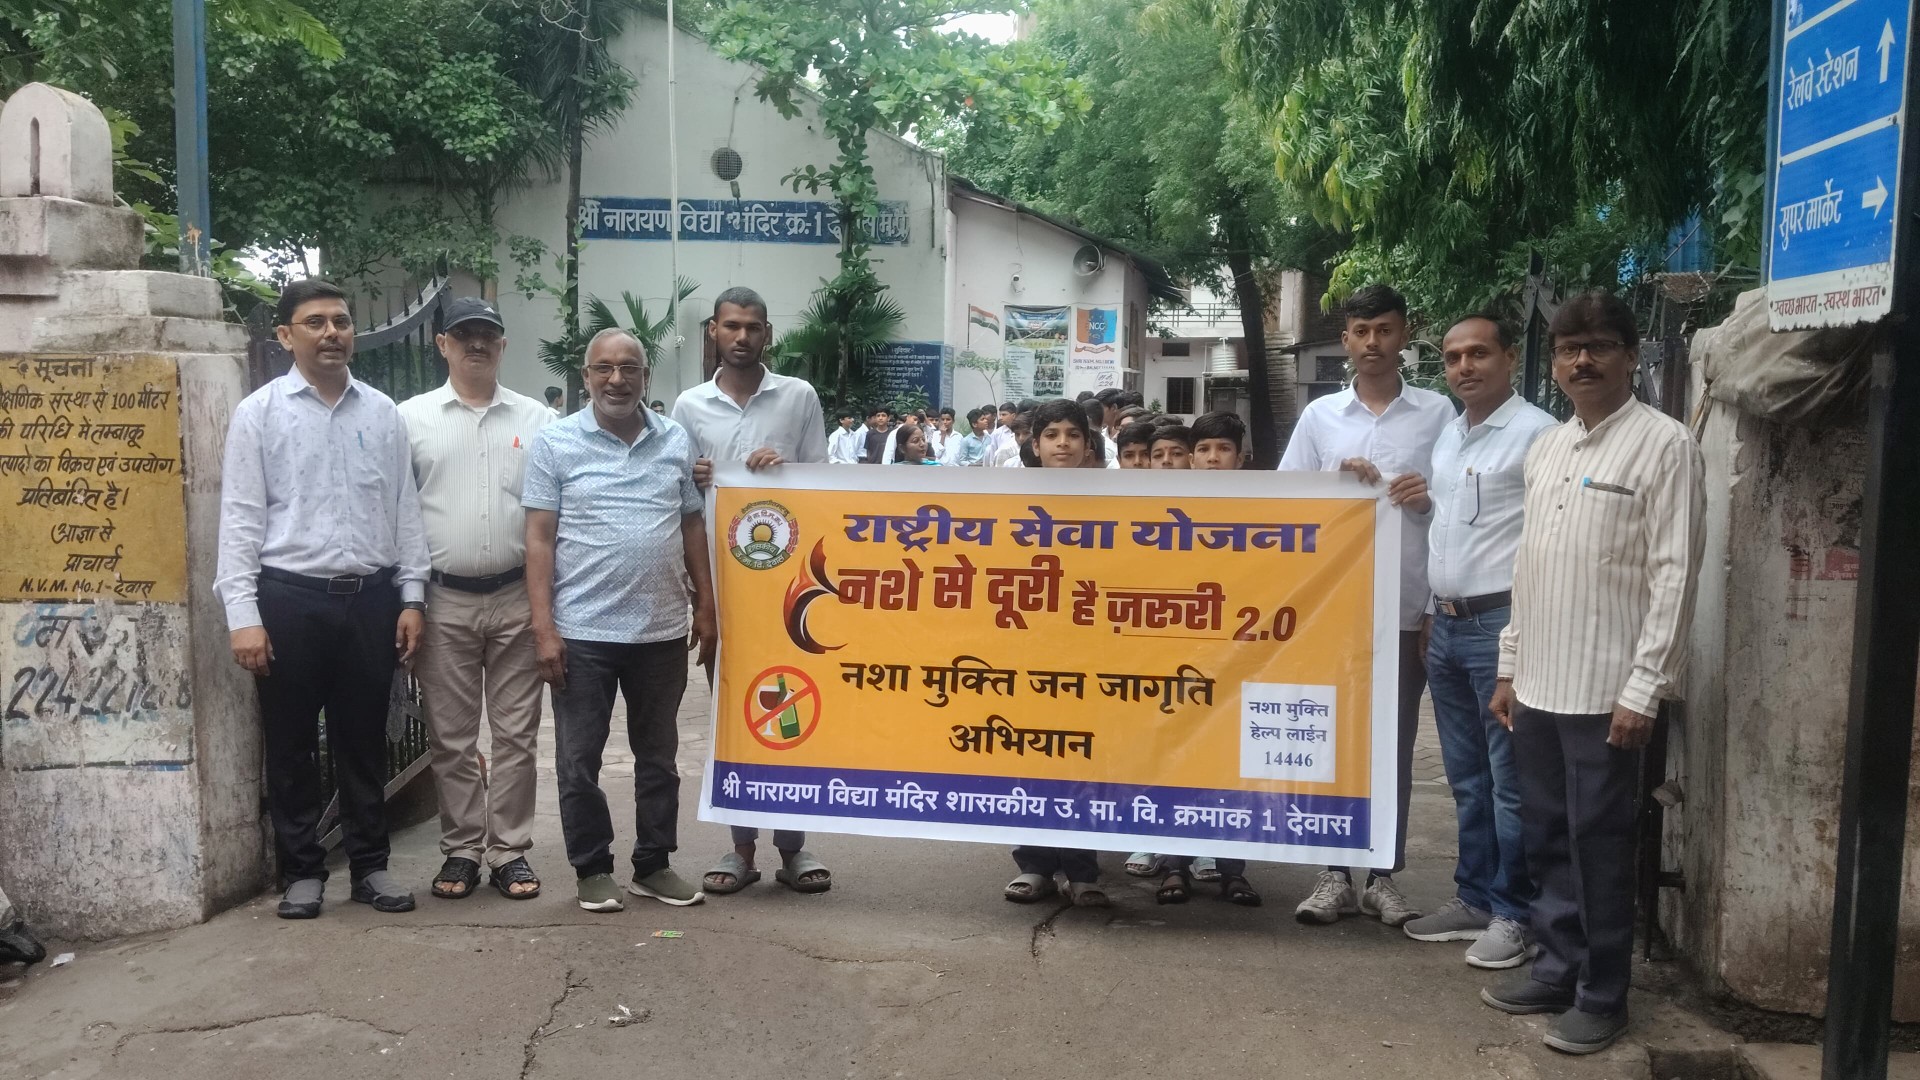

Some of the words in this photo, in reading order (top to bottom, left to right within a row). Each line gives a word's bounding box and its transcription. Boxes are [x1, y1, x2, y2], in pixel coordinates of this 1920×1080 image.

[1787, 57, 1814, 110] रेलवे
[1815, 46, 1861, 97] स्टेशन
[579, 199, 601, 231] श्री
[602, 208, 672, 233] नारायण
[678, 201, 725, 234] विद्या
[1779, 203, 1805, 251] सुपर
[1806, 178, 1844, 231] मार्केट
[1824, 289, 1851, 311] स्वस्थ
[1852, 285, 1882, 308] भारत
[1088, 322, 1106, 330] NCC
[34, 357, 96, 383] सूचना
[93, 384, 108, 413] से
[111, 393, 136, 410] 100
[137, 382, 171, 410] मीटर
[20, 415, 74, 443] परिधि
[78, 416, 92, 440] में
[91, 424, 146, 449] तम्बाकू
[33, 455, 55, 473] का
[58, 448, 96, 475] विक्रय
[96, 451, 118, 476] एवं
[119, 453, 176, 474] उपयोग
[51, 523, 99, 544] आज्ञा
[99, 518, 116, 542] से
[843, 504, 998, 552] राष्ट्रीय
[1010, 505, 1119, 549] सेवा
[1131, 507, 1321, 553] योजना
[62, 544, 124, 572] प्राचार्य
[837, 558, 924, 611] नशे
[933, 554, 978, 609] से
[986, 554, 1065, 629] दूरी
[1072, 580, 1099, 626] है
[1232, 606, 1297, 642] 2.0
[839, 662, 912, 692] नशा
[920, 655, 1018, 708] मुक्ति
[1027, 670, 1087, 700] जन
[1096, 664, 1216, 714] जागृति
[1249, 701, 1281, 715] नशा
[1285, 698, 1330, 722] मुक्ति
[949, 714, 1096, 760] अभियान
[1250, 721, 1281, 740] हेल्प
[1286, 724, 1328, 743] लाईन
[1264, 751, 1314, 768] 14446
[722, 771, 741, 798] श्री
[746, 780, 822, 804] नारायण
[828, 778, 879, 807] विद्या
[885, 780, 939, 813] मंदिर
[945, 787, 1048, 817] शासकीय
[1054, 798, 1081, 819] उ.
[1089, 800, 1123, 822] मा.
[1132, 795, 1164, 824] वि.
[1174, 798, 1253, 829] क्रमांक
[1262, 808, 1276, 831] 1
[1286, 804, 1354, 836] देवास
